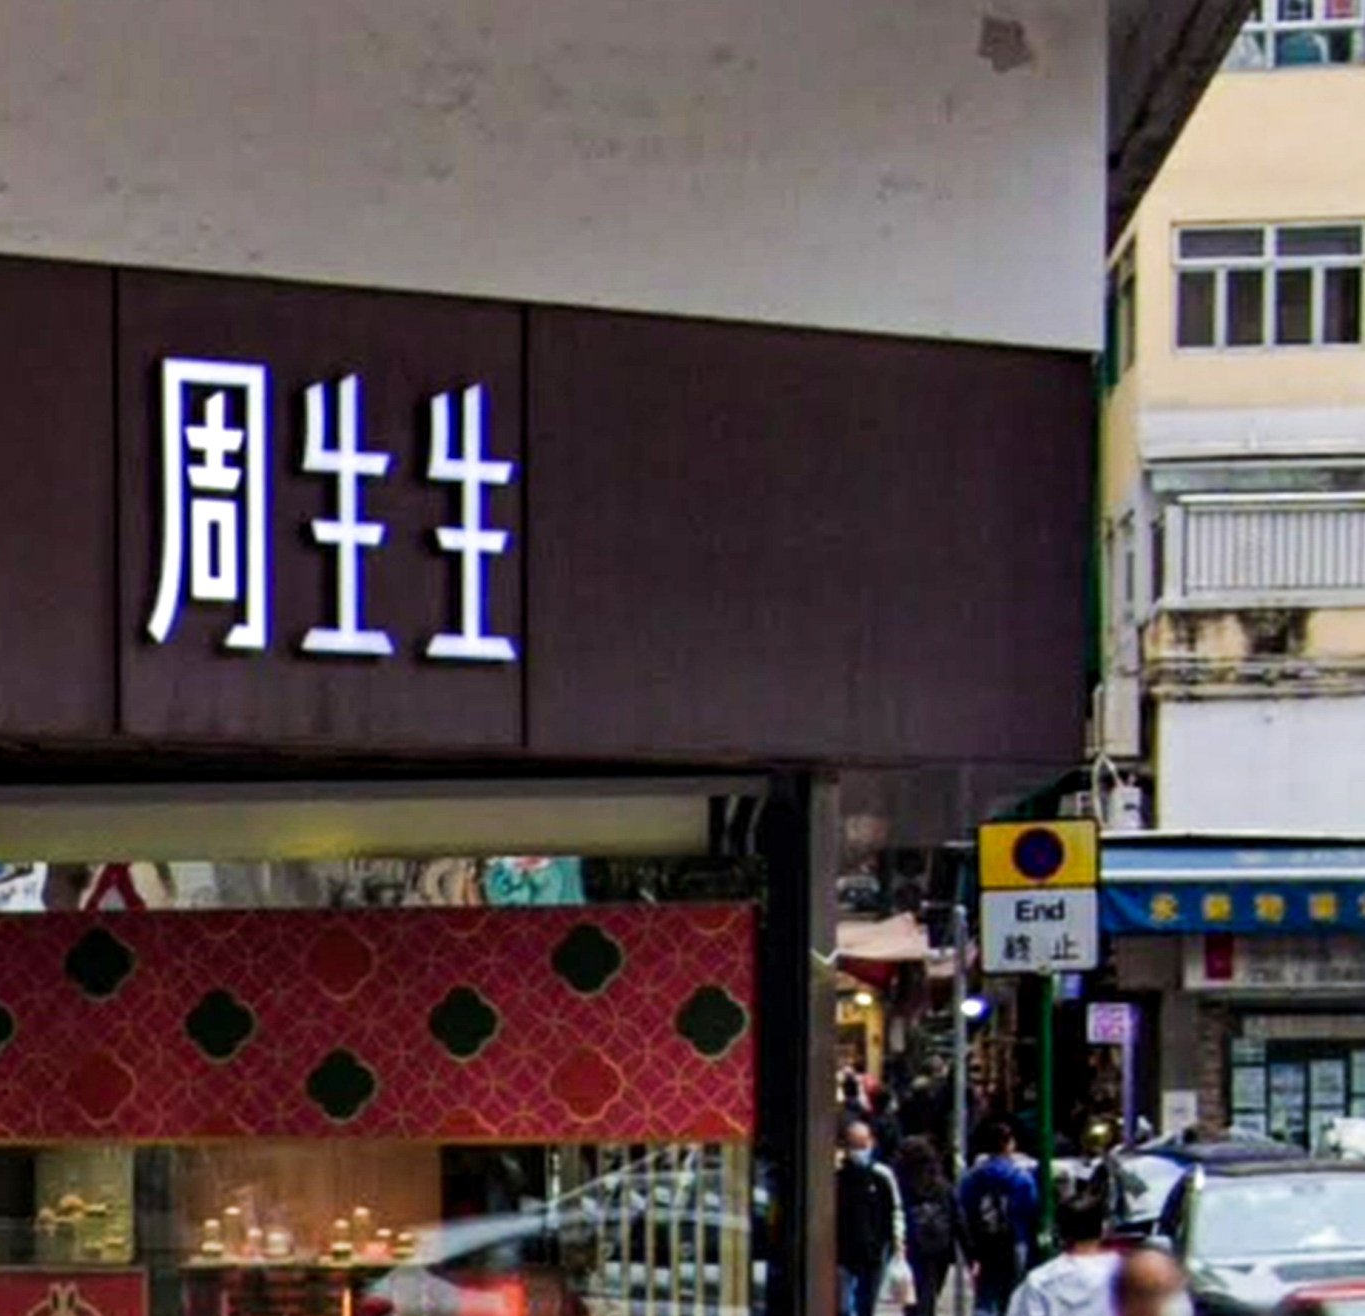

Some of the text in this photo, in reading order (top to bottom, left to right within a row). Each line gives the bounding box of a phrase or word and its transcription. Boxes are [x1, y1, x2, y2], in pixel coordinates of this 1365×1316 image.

[147, 357, 516, 661] 周生生
[1015, 898, 1065, 921] End
[1003, 933, 1081, 961] 終止
